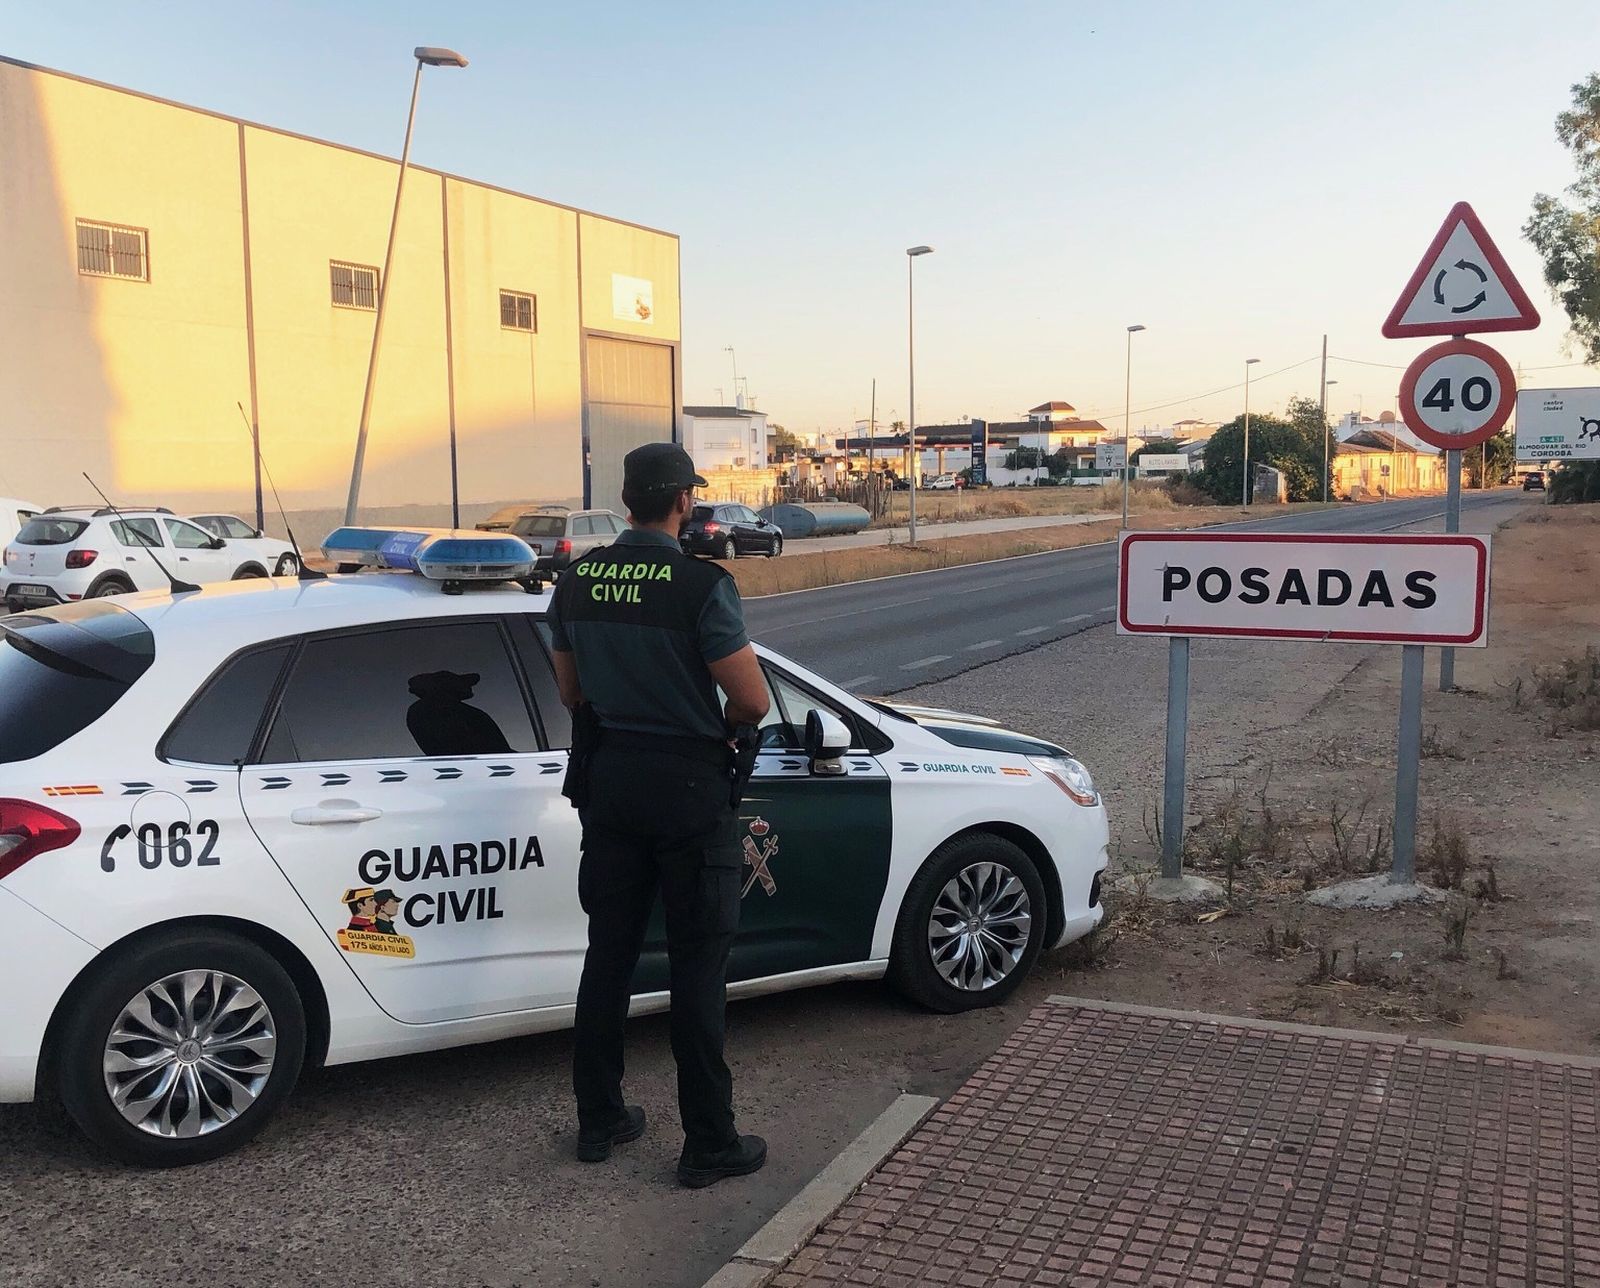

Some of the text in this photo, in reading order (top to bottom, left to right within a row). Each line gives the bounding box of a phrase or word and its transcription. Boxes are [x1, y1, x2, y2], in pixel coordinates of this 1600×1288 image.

[1422, 376, 1492, 412] 40
[576, 562, 672, 581] GUARDIA
[591, 583, 642, 603] CIVIL
[1162, 566, 1437, 609] POSADAS
[923, 763, 996, 774] GUARDIA CIVIL
[138, 819, 221, 870] 062
[358, 835, 545, 885] GUARDIA
[403, 887, 504, 928] CIVIL
[347, 932, 409, 945] GUARDIA CIVIL
[350, 941, 368, 950] 175
[368, 943, 384, 952] AÑOS
[383, 945, 389, 953] A
